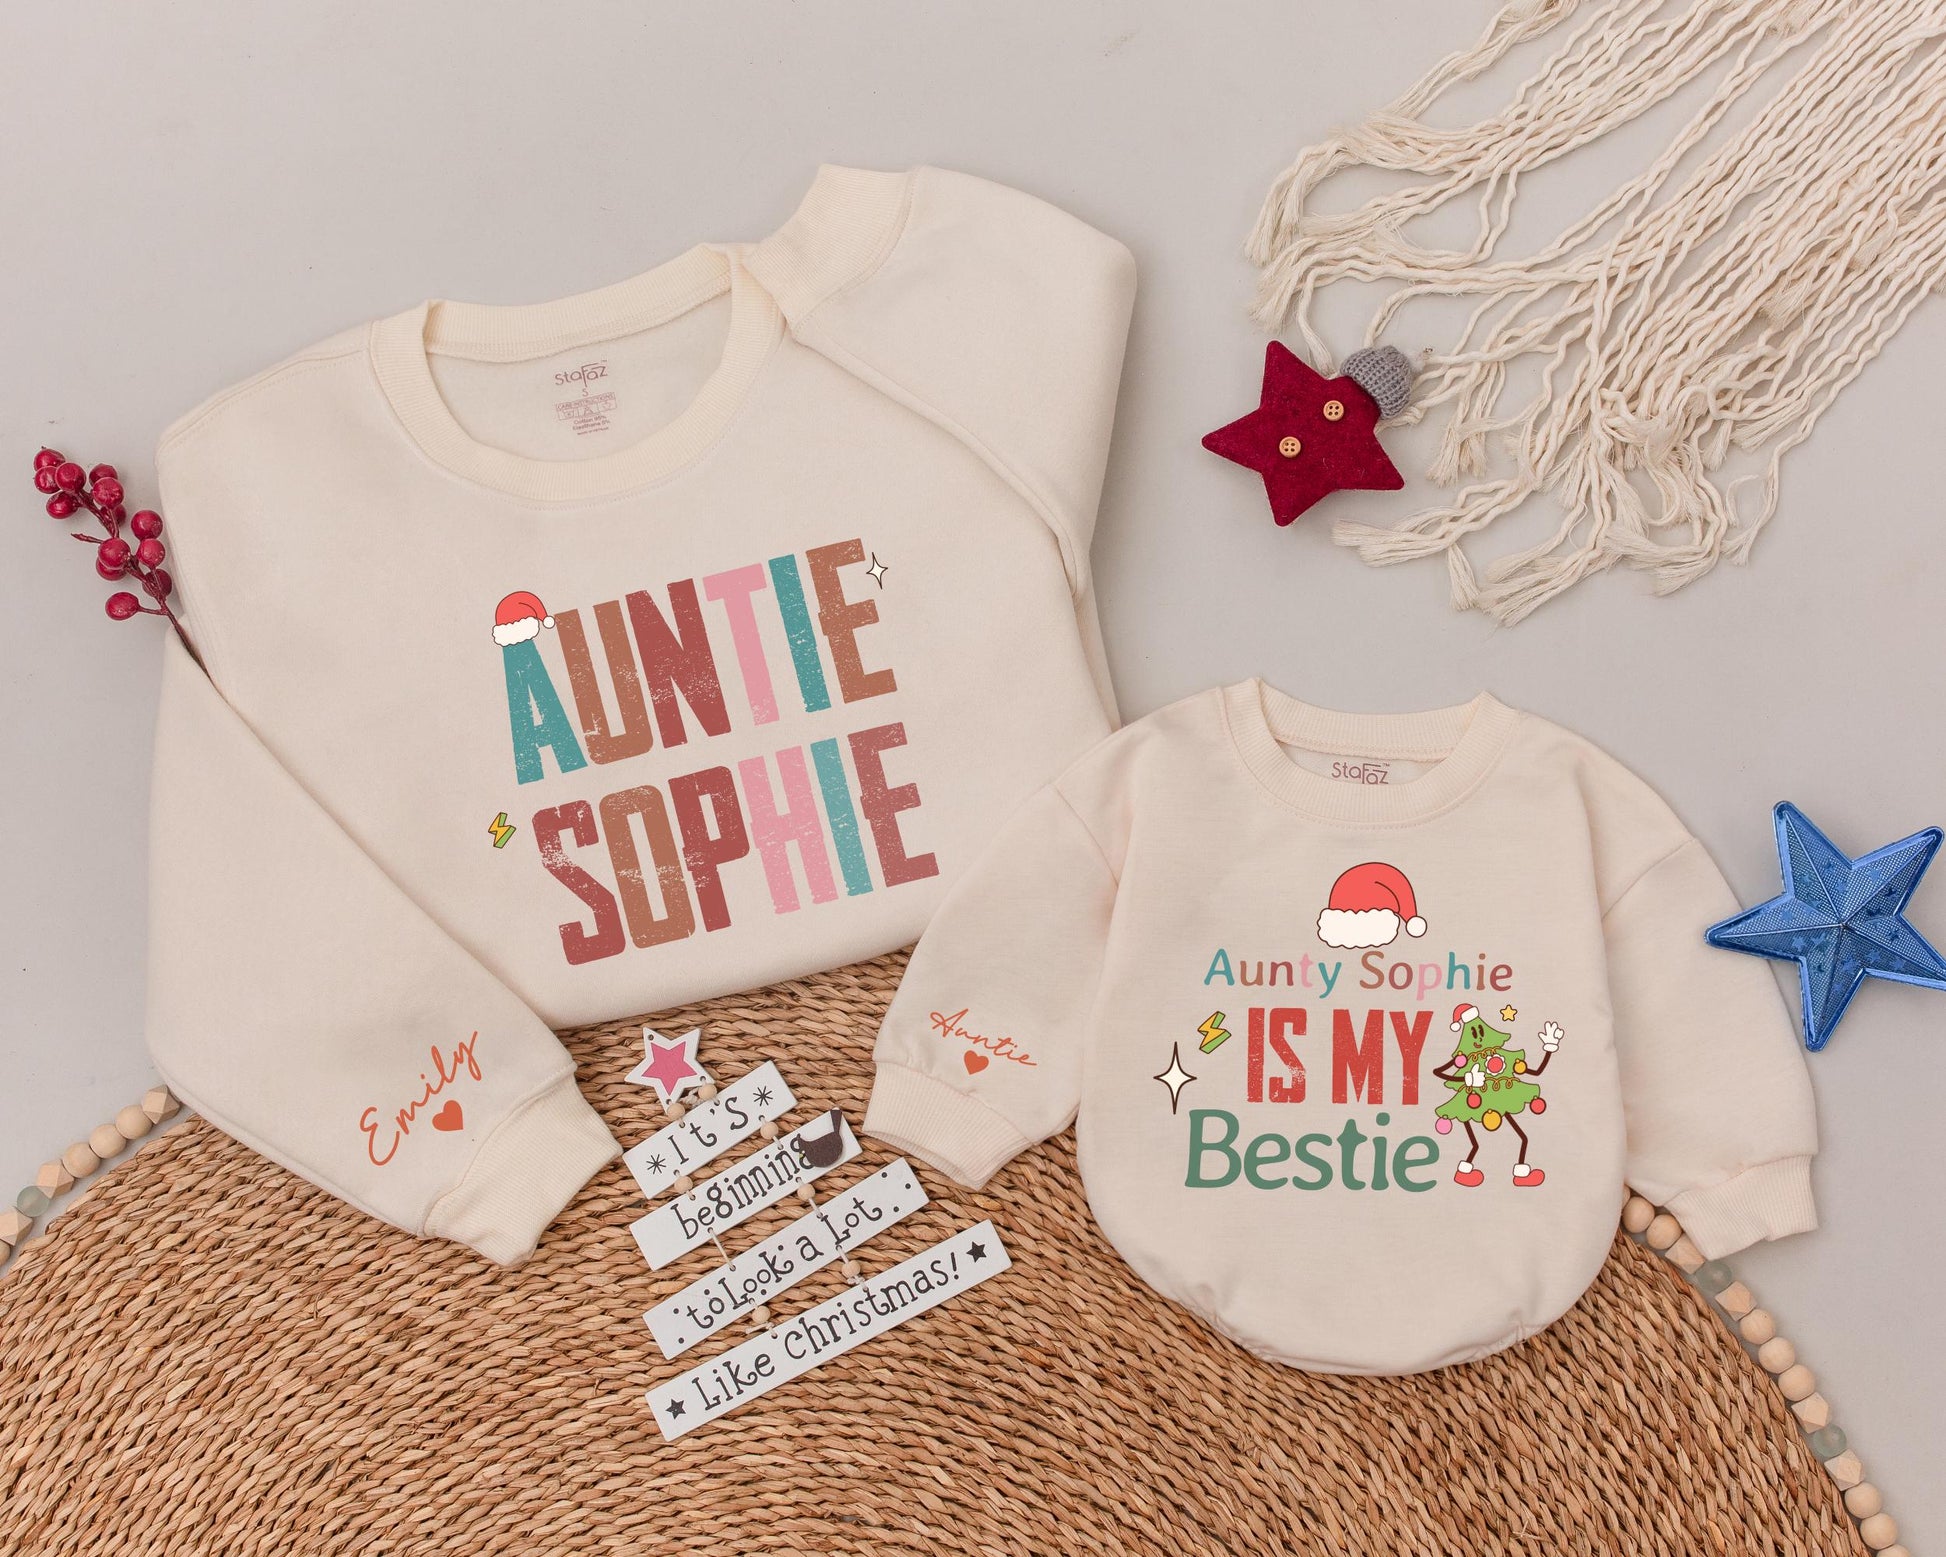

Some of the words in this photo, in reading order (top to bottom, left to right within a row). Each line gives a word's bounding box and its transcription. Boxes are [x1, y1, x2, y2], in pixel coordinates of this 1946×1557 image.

[582, 388, 589, 397] S
[500, 538, 898, 785] AUNTIE
[532, 722, 940, 965] SOPHIE
[1204, 948, 1343, 999] Aunty
[1359, 951, 1513, 1001] Sophie
[930, 1008, 1037, 1066] Auntie
[1247, 1007, 1307, 1104] IS
[1332, 1009, 1434, 1105] MY
[359, 1030, 482, 1166] Emily
[1185, 1109, 1440, 1192] Bestie
[795, 1234, 824, 1265] a
[691, 1353, 775, 1411] Like
